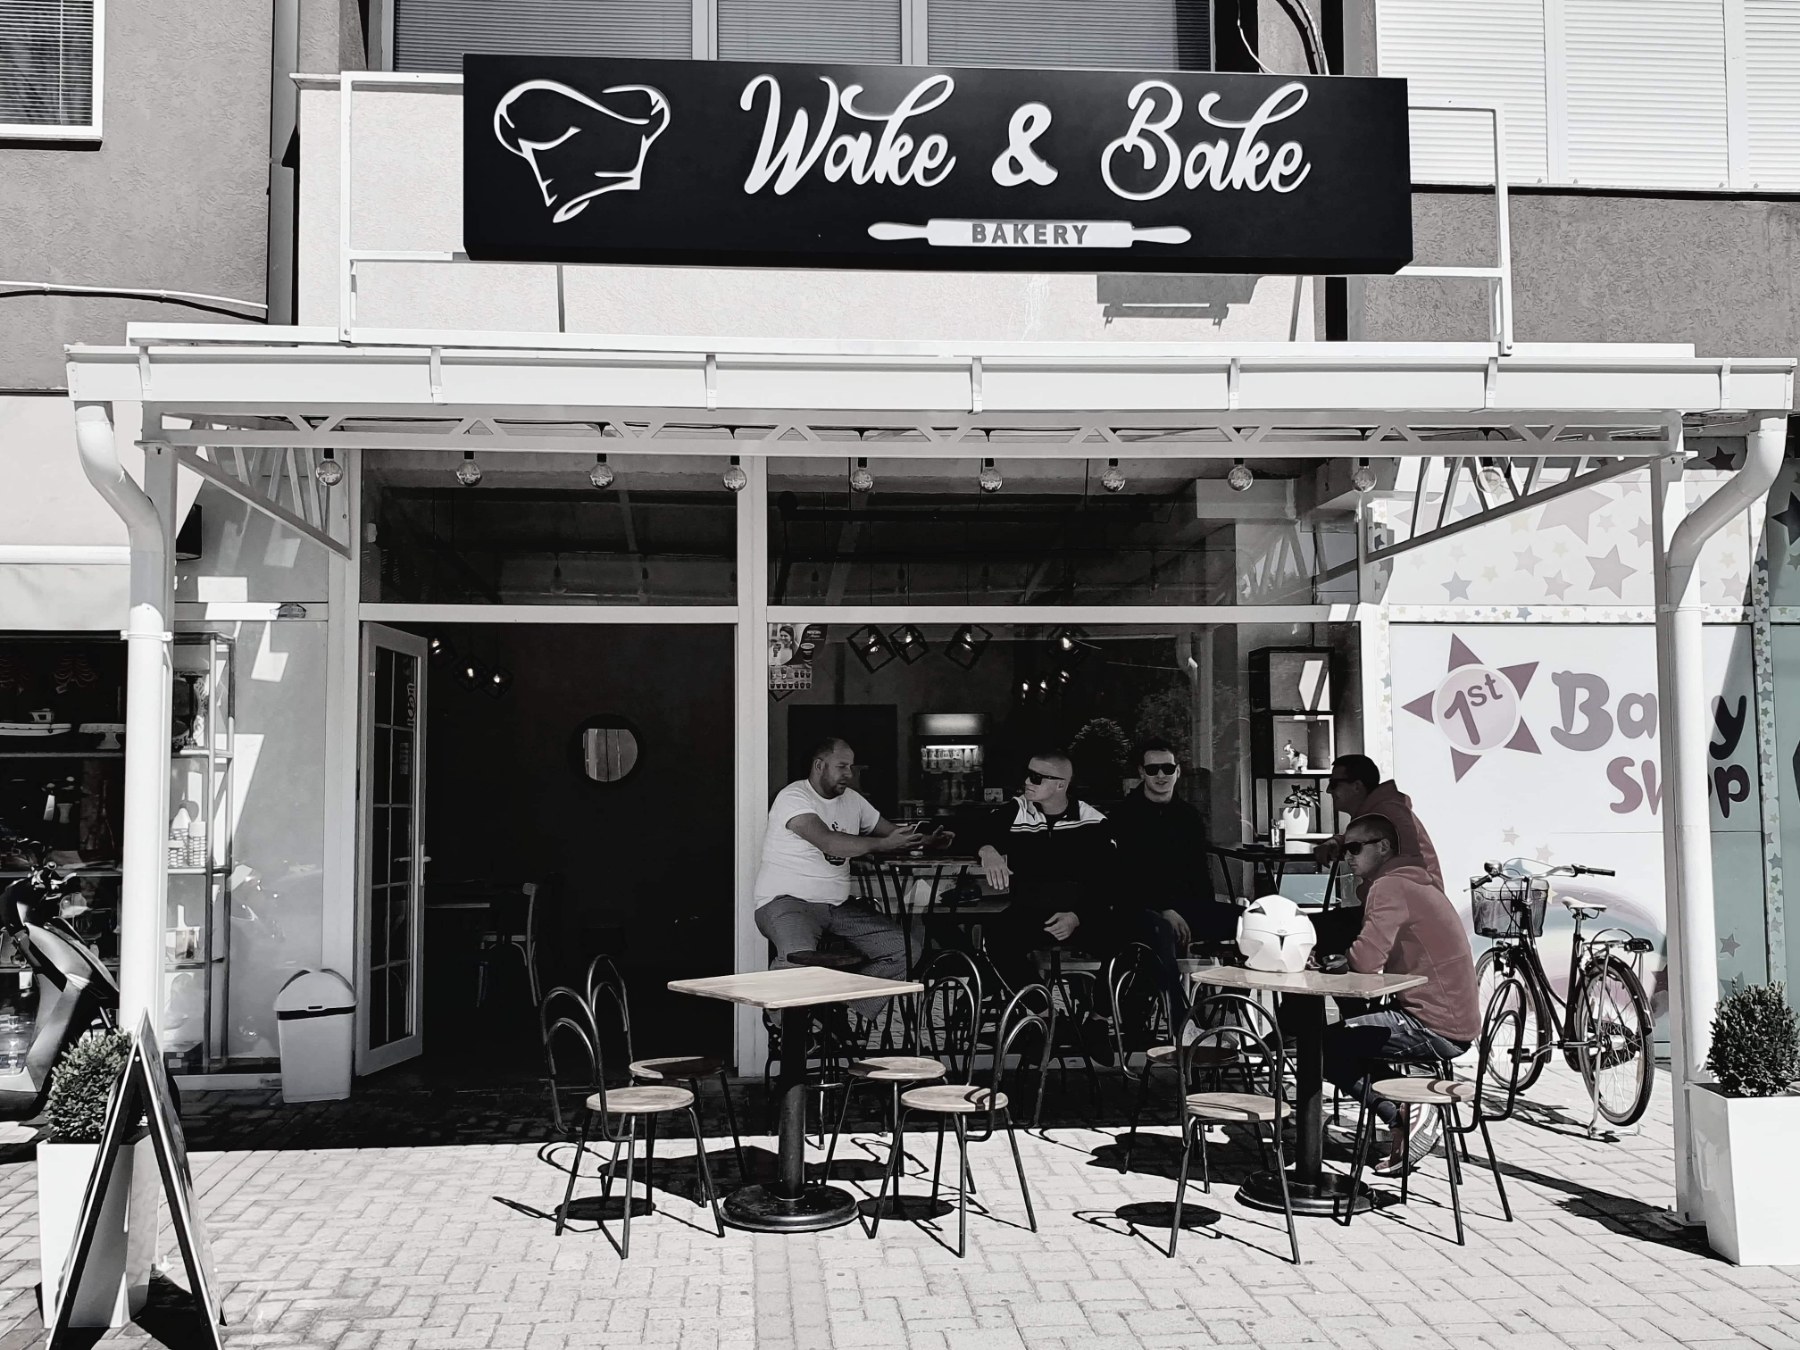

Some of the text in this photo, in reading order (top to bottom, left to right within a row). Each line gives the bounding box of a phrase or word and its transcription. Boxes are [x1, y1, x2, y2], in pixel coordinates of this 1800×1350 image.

[740, 74, 1311, 201] Wake & Bake
[972, 223, 1089, 245] BAKERY
[1443, 670, 1747, 760] 1st Bay
